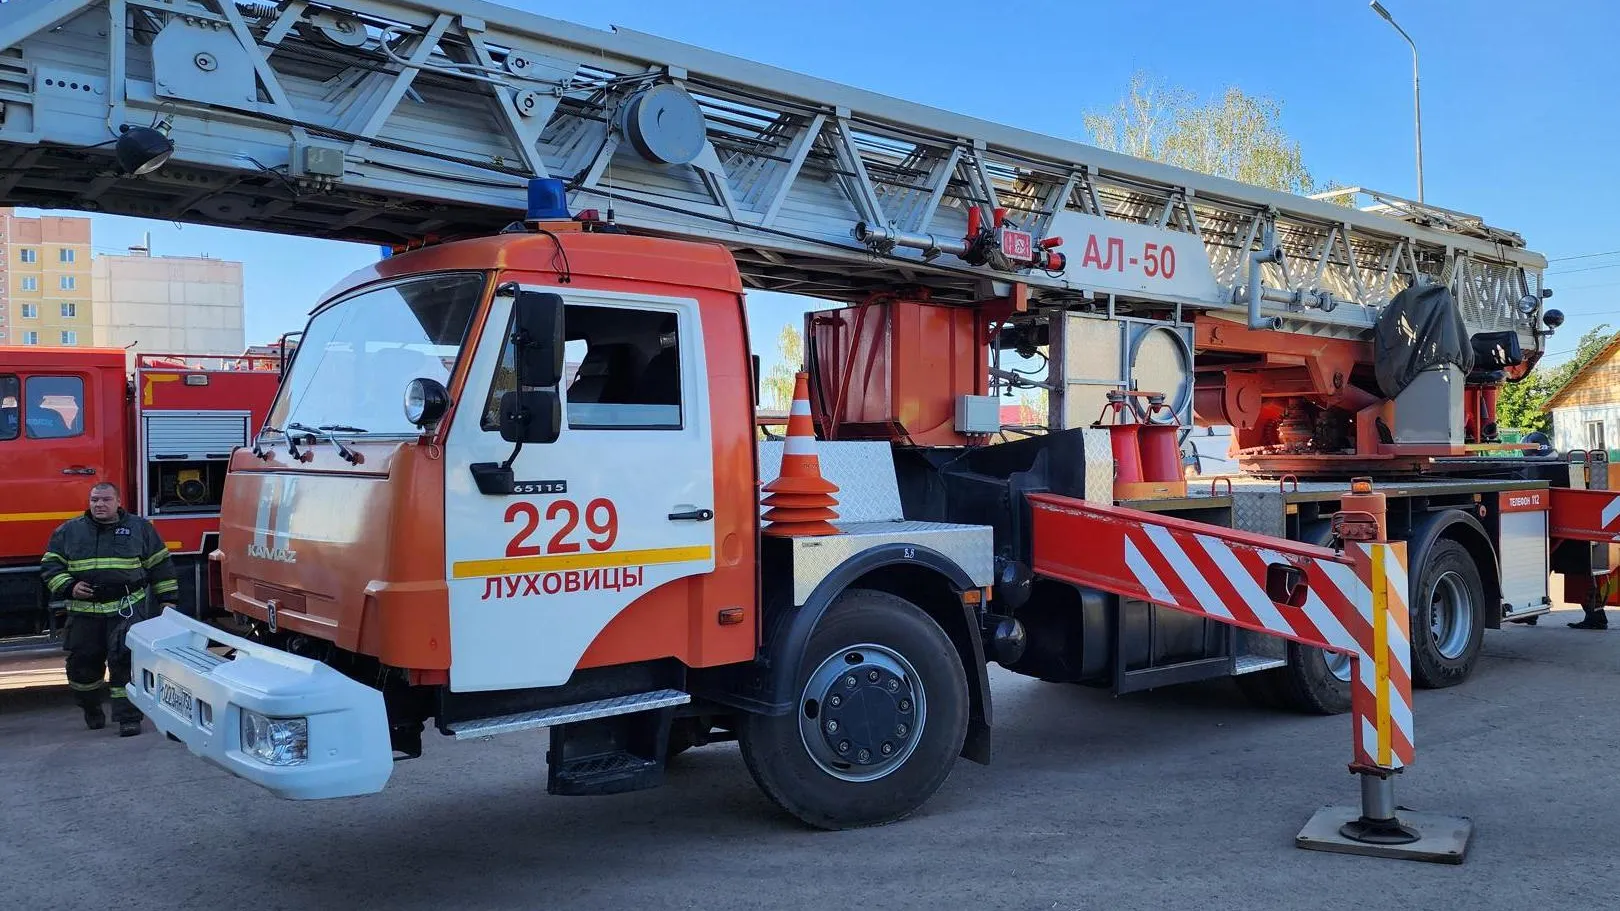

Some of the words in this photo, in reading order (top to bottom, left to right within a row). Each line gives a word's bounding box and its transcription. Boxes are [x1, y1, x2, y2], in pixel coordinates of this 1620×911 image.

[1082, 234, 1176, 279] АЛ-50
[513, 483, 565, 493] 65115
[1509, 496, 1531, 507] ТЕЛЕФОН
[1531, 494, 1540, 505] 112
[504, 497, 619, 558] 229
[248, 544, 297, 563] KAMAZ
[481, 566, 644, 600] ЛУХОВИЦЫ
